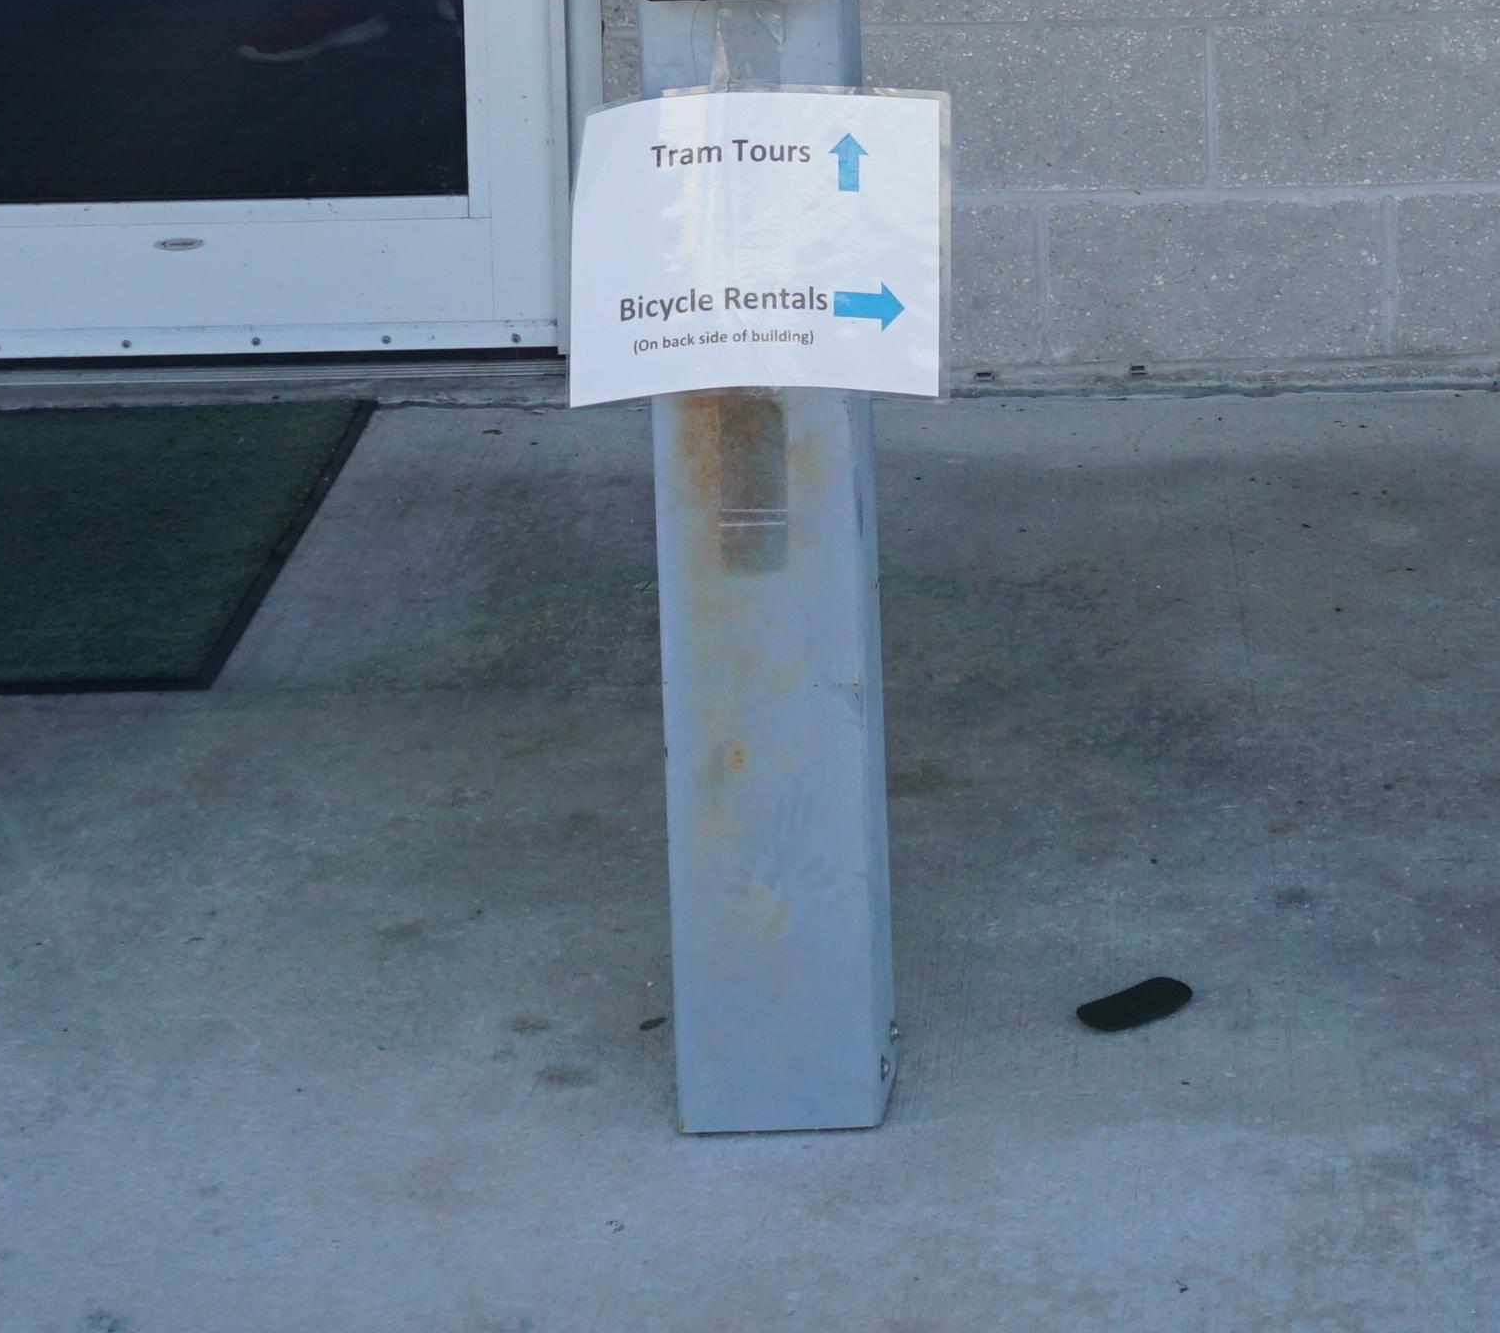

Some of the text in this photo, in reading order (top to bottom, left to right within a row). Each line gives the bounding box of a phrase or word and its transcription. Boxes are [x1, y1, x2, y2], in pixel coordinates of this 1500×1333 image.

[651, 139, 811, 167] Tram Tours
[620, 286, 827, 321] Bicycle Rentals
[634, 329, 814, 355] (On back side of building)
